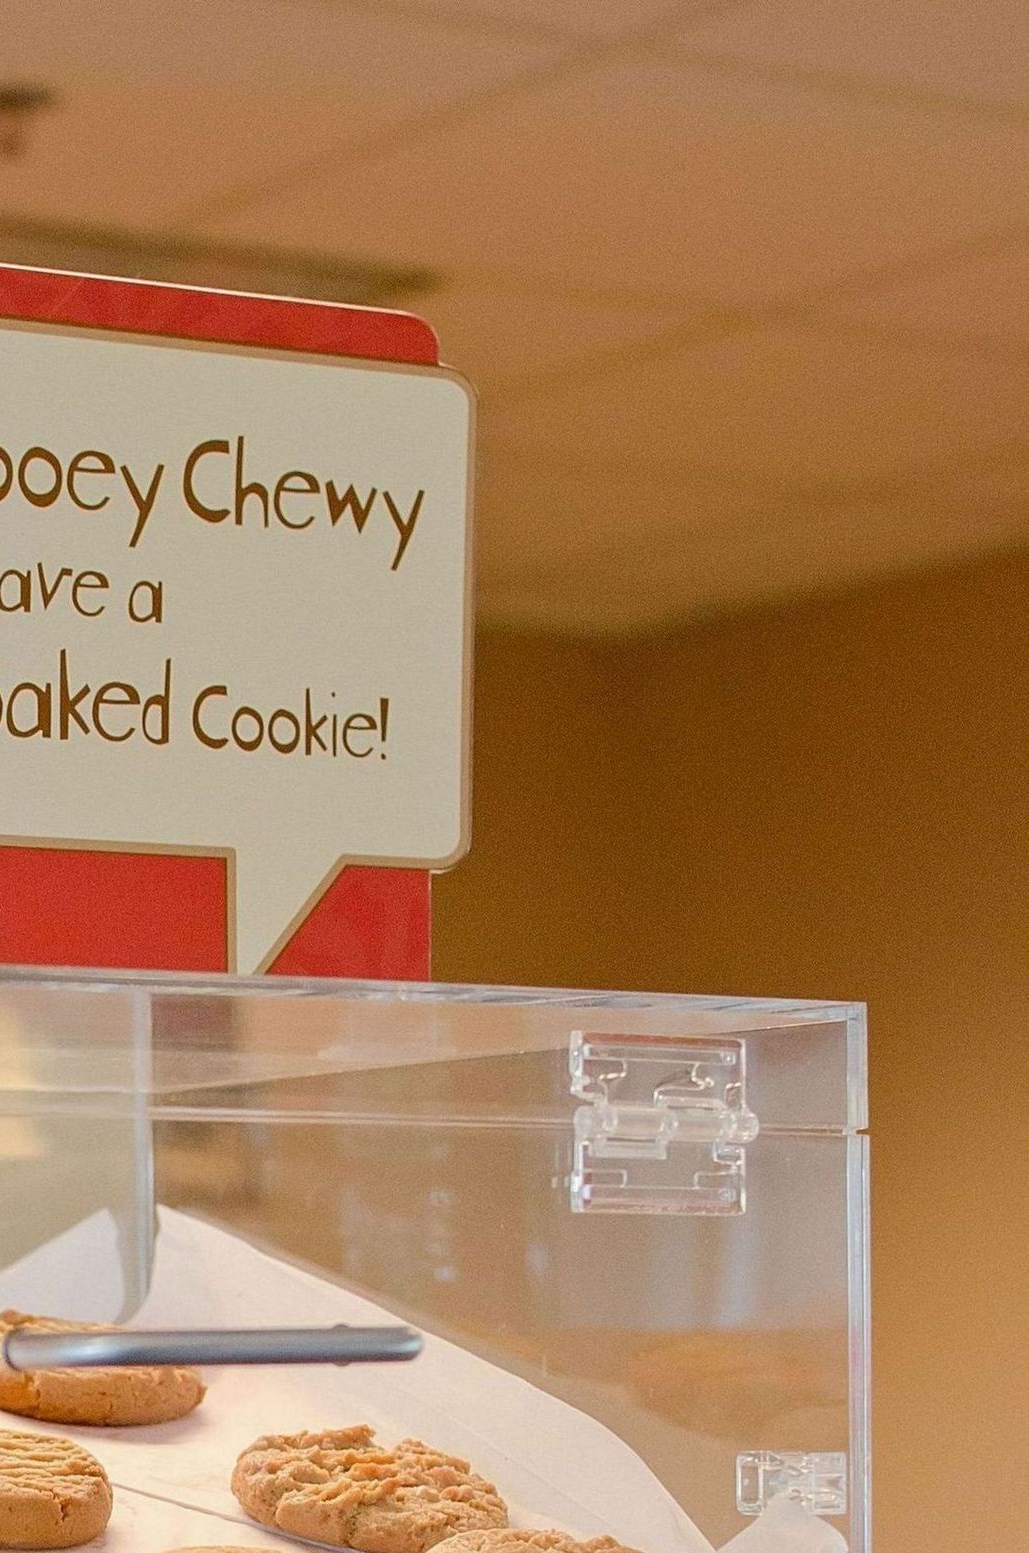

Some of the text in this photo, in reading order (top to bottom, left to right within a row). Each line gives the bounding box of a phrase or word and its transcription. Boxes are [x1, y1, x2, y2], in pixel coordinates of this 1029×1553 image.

[183, 436, 425, 571] Chewy
[128, 578, 165, 624] a
[192, 685, 390, 760] Cookie!
